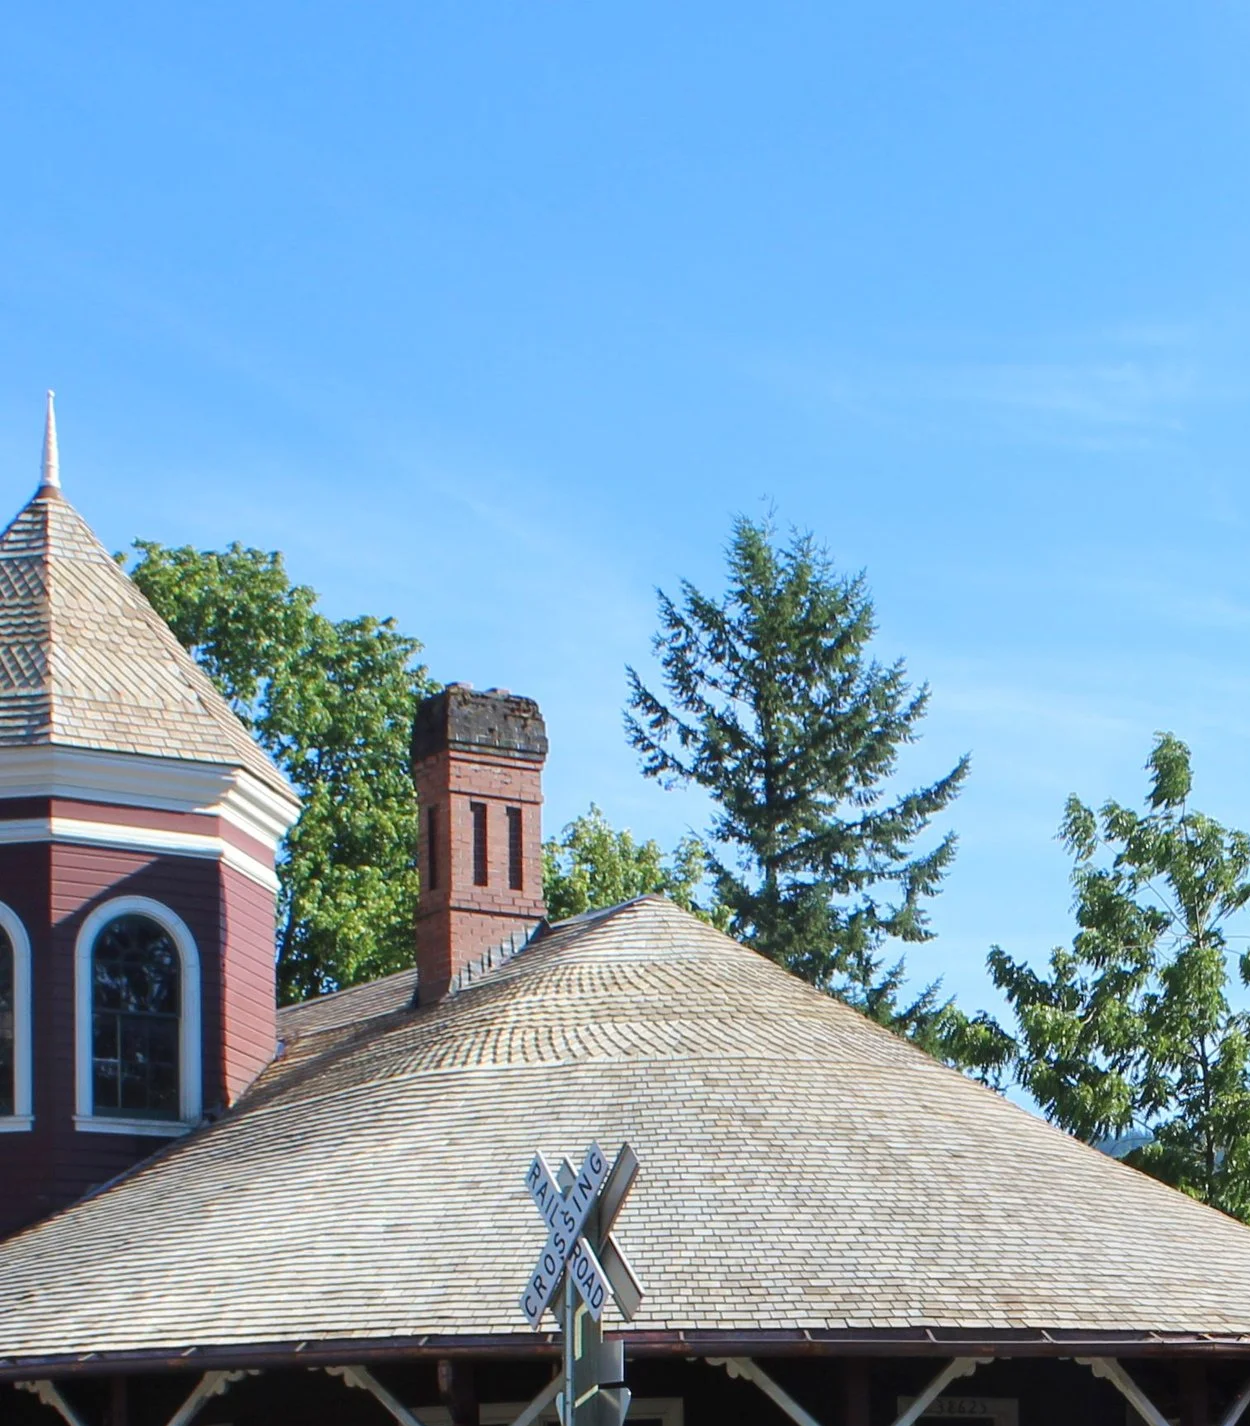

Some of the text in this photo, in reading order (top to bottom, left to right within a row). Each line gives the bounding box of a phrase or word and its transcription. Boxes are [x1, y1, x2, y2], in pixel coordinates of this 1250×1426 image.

[525, 1152, 603, 1318] CROSSING
[527, 1162, 605, 1310] RAIL ROAD
